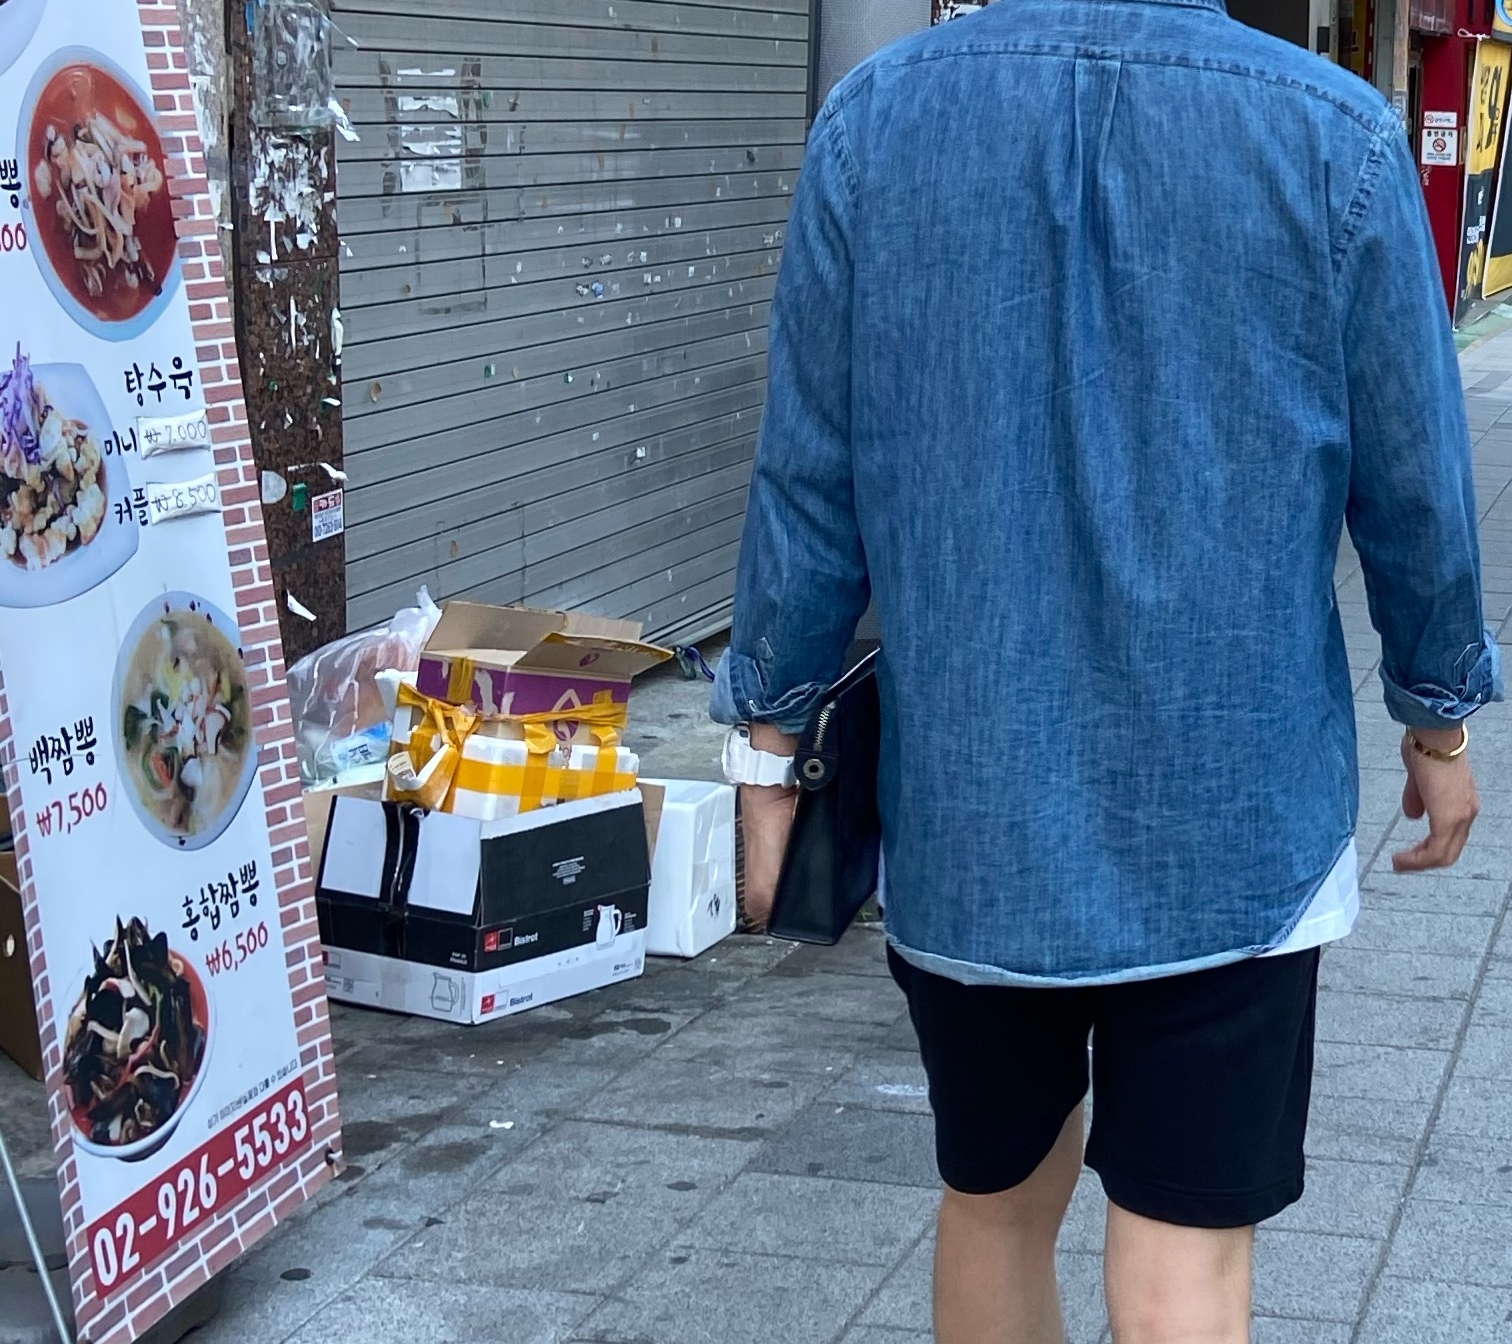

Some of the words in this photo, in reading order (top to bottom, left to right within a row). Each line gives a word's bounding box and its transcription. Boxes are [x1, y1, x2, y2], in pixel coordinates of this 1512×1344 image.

[124, 356, 194, 407] 탕수육
[103, 427, 139, 456] 미니
[114, 487, 151, 525] 커플
[28, 715, 98, 786] 백짬뽕
[36, 780, 108, 838] ₩7,500
[180, 860, 262, 942] 홍합짬뽕
[205, 920, 270, 979] ₩6,500
[514, 931, 539, 947] Bistrot
[509, 992, 534, 1007] Bistrot
[93, 1089, 308, 1291] 02-926-5533
